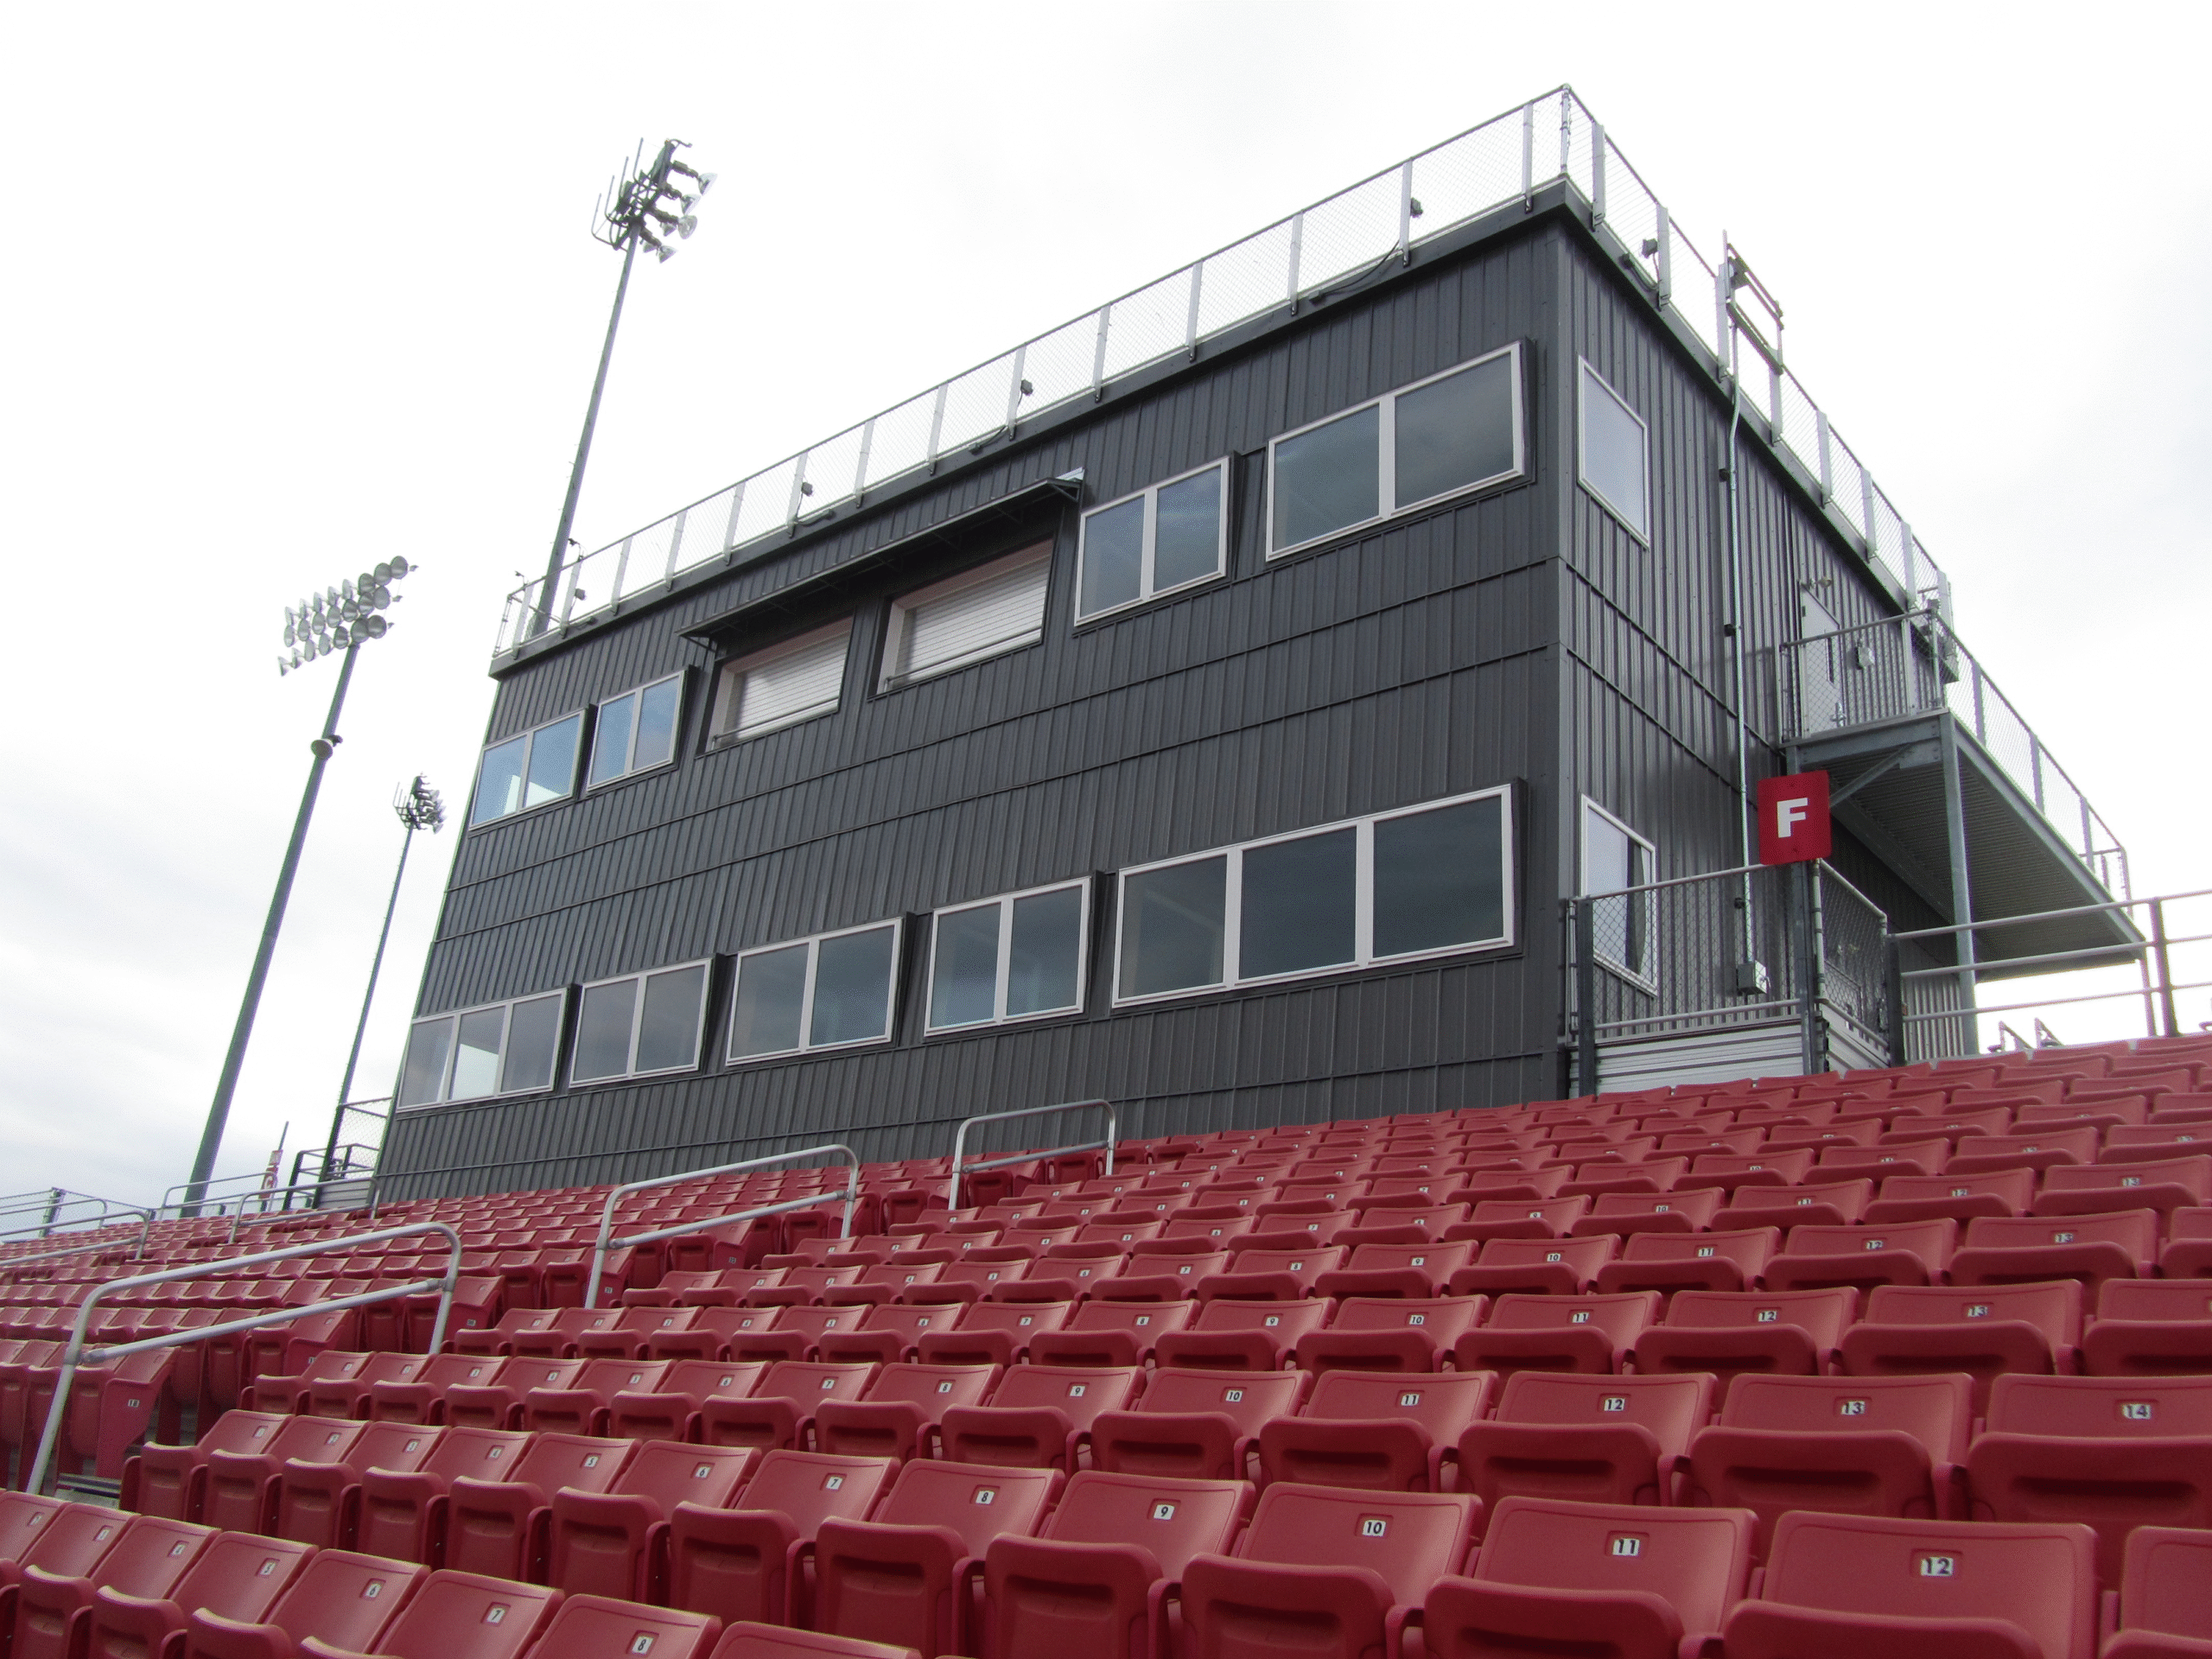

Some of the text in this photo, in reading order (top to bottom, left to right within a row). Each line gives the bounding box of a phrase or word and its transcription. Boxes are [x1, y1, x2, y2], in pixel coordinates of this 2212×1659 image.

[1777, 798, 1808, 838] F
[2058, 1234, 2072, 1243] 13
[1762, 1312, 1775, 1320] 12
[1972, 1306, 1986, 1316] 13
[1229, 1391, 1240, 1401] 10
[1404, 1395, 1417, 1405] 11
[1607, 1399, 1623, 1410] 12
[1845, 1402, 1861, 1414] 13
[2127, 1405, 2147, 1418] 14
[830, 1478, 839, 1487] 7
[982, 1491, 988, 1502] 8
[1160, 1506, 1168, 1517] 9
[1367, 1522, 1382, 1535] 10
[1619, 1539, 1636, 1554] 11
[1927, 1557, 1949, 1574] 12
[370, 1586, 377, 1595] 6
[492, 1610, 500, 1620] 7
[638, 1639, 646, 1651] 8
